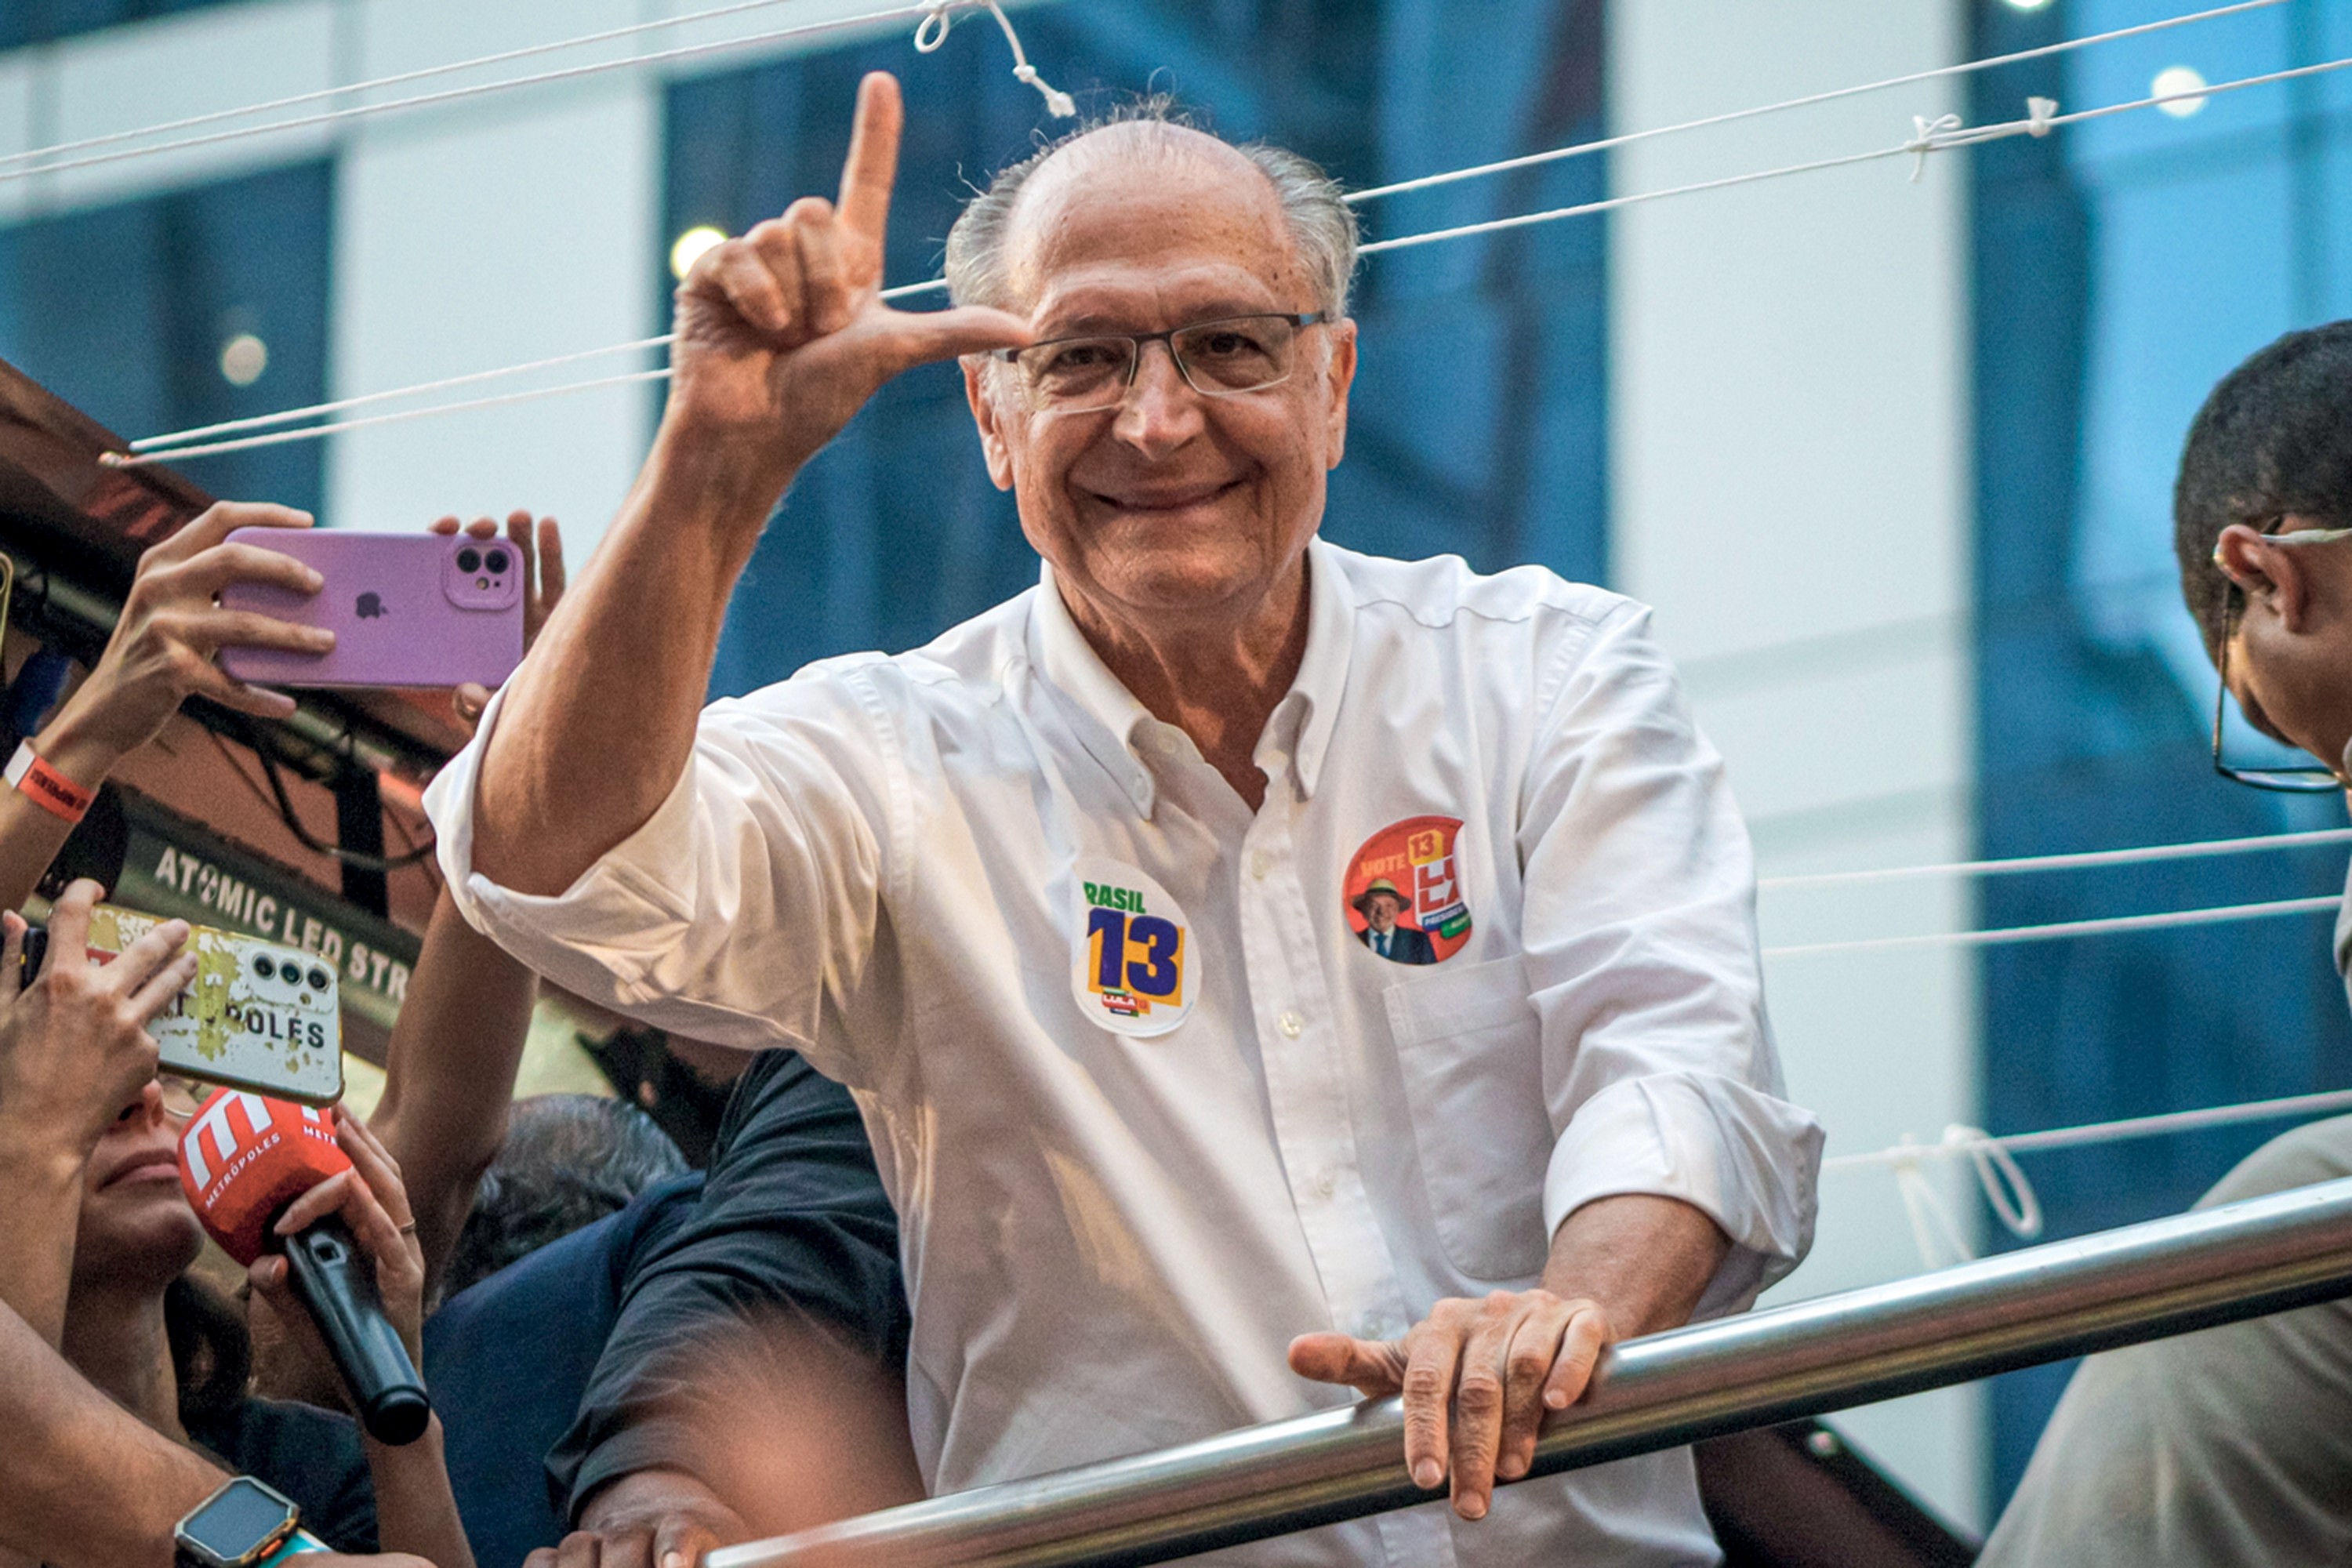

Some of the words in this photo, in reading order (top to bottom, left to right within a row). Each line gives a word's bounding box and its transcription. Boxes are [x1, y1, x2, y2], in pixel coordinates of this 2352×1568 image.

[1360, 852, 1406, 877] VOTE
[1411, 833, 1435, 859] 13
[154, 846, 277, 934] ATOMIC
[281, 907, 343, 961] LED
[1087, 907, 1179, 996] 13
[205, 1133, 281, 1209] METRÓPOLES
